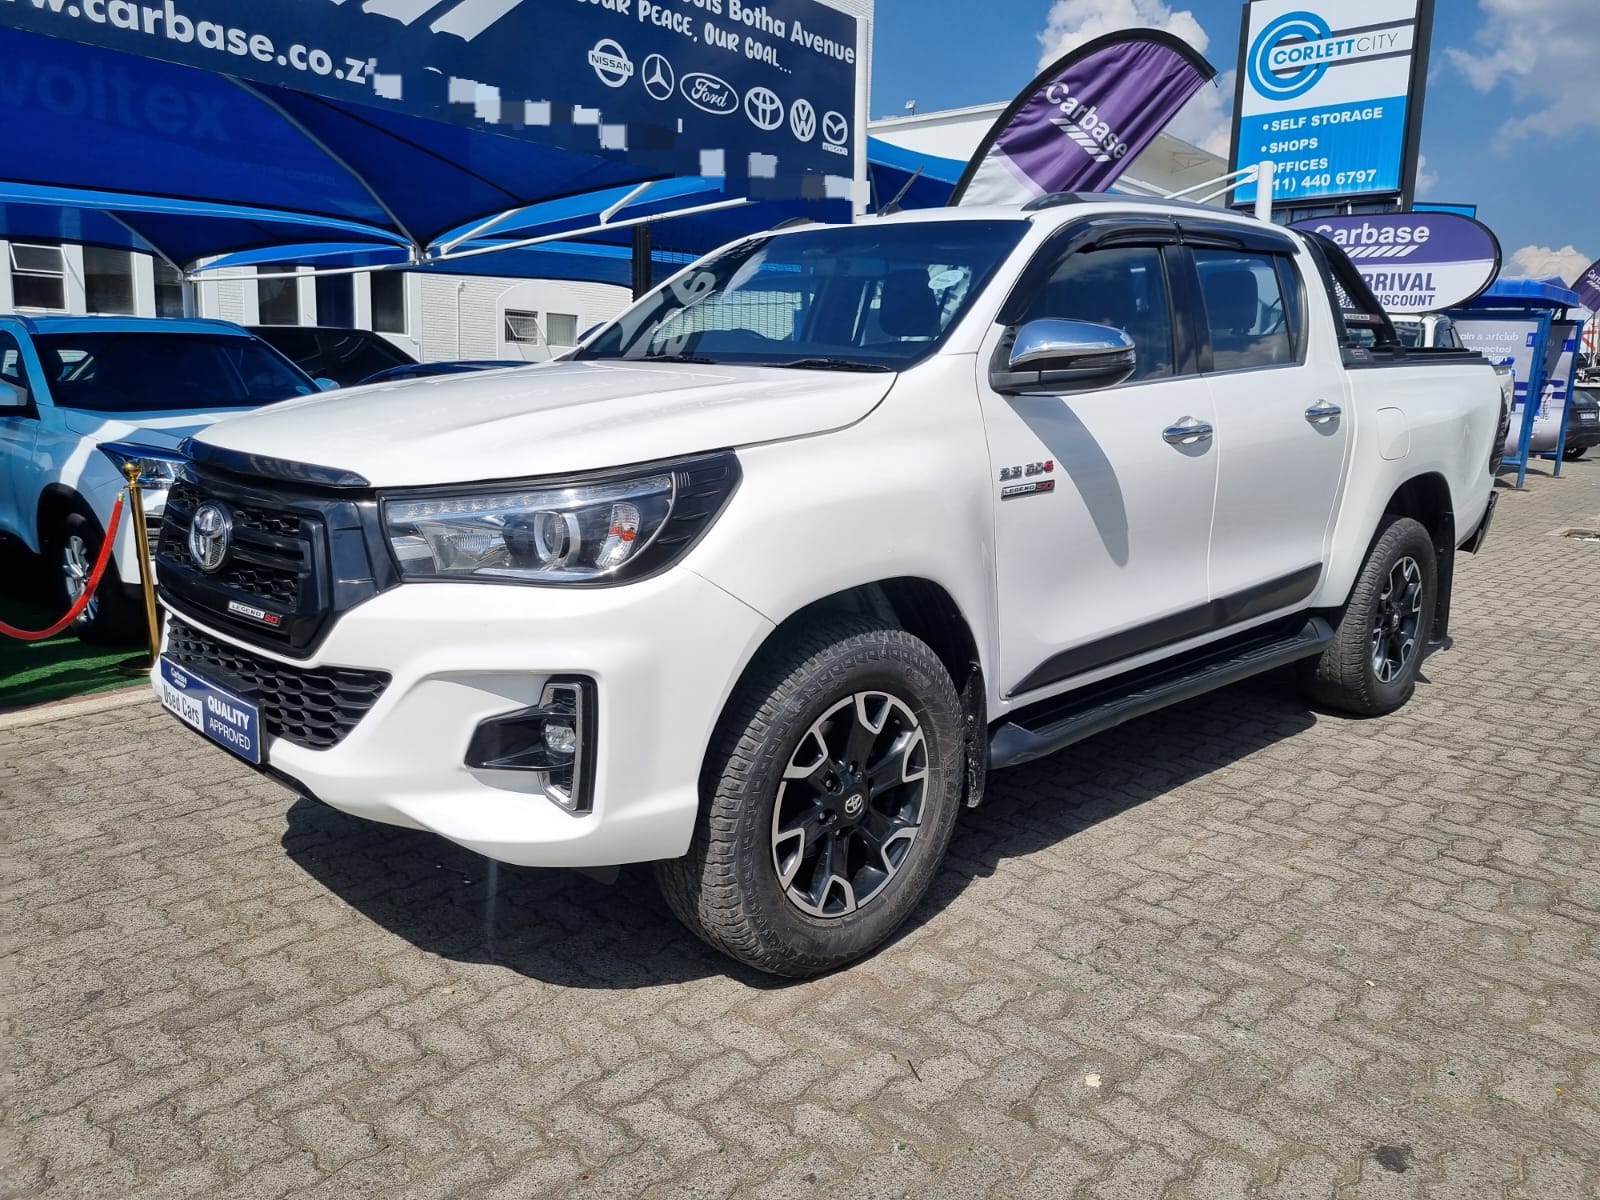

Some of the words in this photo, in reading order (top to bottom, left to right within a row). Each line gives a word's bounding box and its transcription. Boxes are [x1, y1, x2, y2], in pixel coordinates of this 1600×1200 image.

[577, 0, 631, 16] UR
[704, 22, 739, 52] OUR
[729, 0, 786, 38] Botha
[790, 21, 855, 64] Avenue
[8, 0, 385, 85] .carbase.co.z
[591, 53, 631, 73] NISSAN
[691, 77, 729, 108] Ford
[1046, 82, 1128, 159] Carbase
[1271, 116, 1307, 131] SELF
[1311, 107, 1383, 127] STORAGE
[1269, 138, 1319, 153] SHOPS
[1301, 173, 1330, 187] 440
[1335, 169, 1376, 185] 6797
[1004, 485, 1035, 495] LEGEND
[231, 602, 262, 618] LEGEND
[163, 684, 180, 711] Used
[182, 697, 200, 725] Cars
[208, 696, 250, 730] QUALITY
[209, 718, 251, 750] APPROVED
